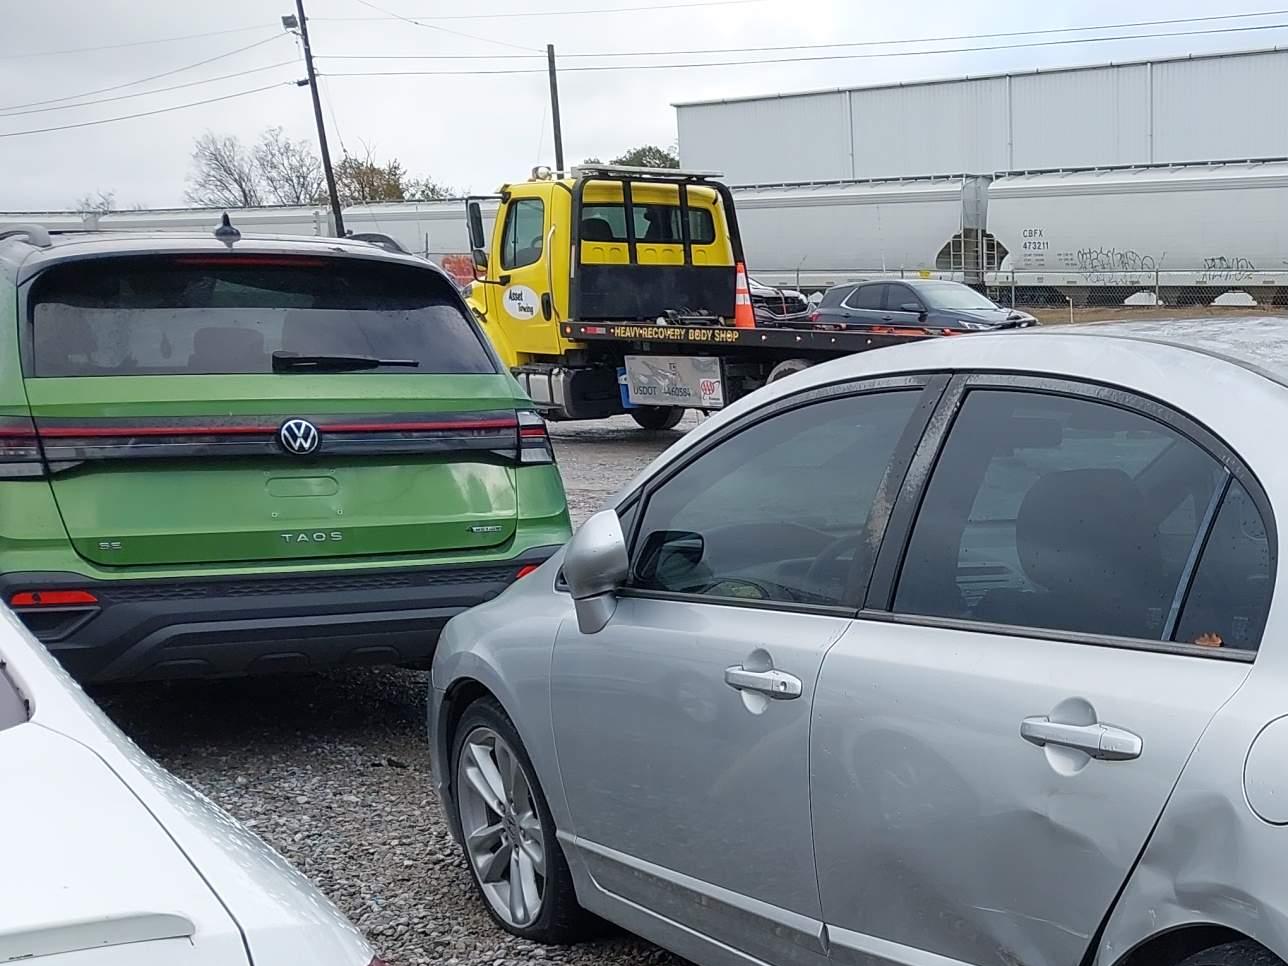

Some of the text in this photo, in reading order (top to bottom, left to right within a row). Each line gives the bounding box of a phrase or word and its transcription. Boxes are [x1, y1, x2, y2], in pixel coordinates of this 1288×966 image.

[1022, 228, 1043, 238] CBFX
[1022, 241, 1049, 251] 473211
[614, 326, 740, 342] HEAVY RECOVERY BODY SHOP
[633, 385, 657, 396] USDOT
[280, 531, 343, 543] TAOS
